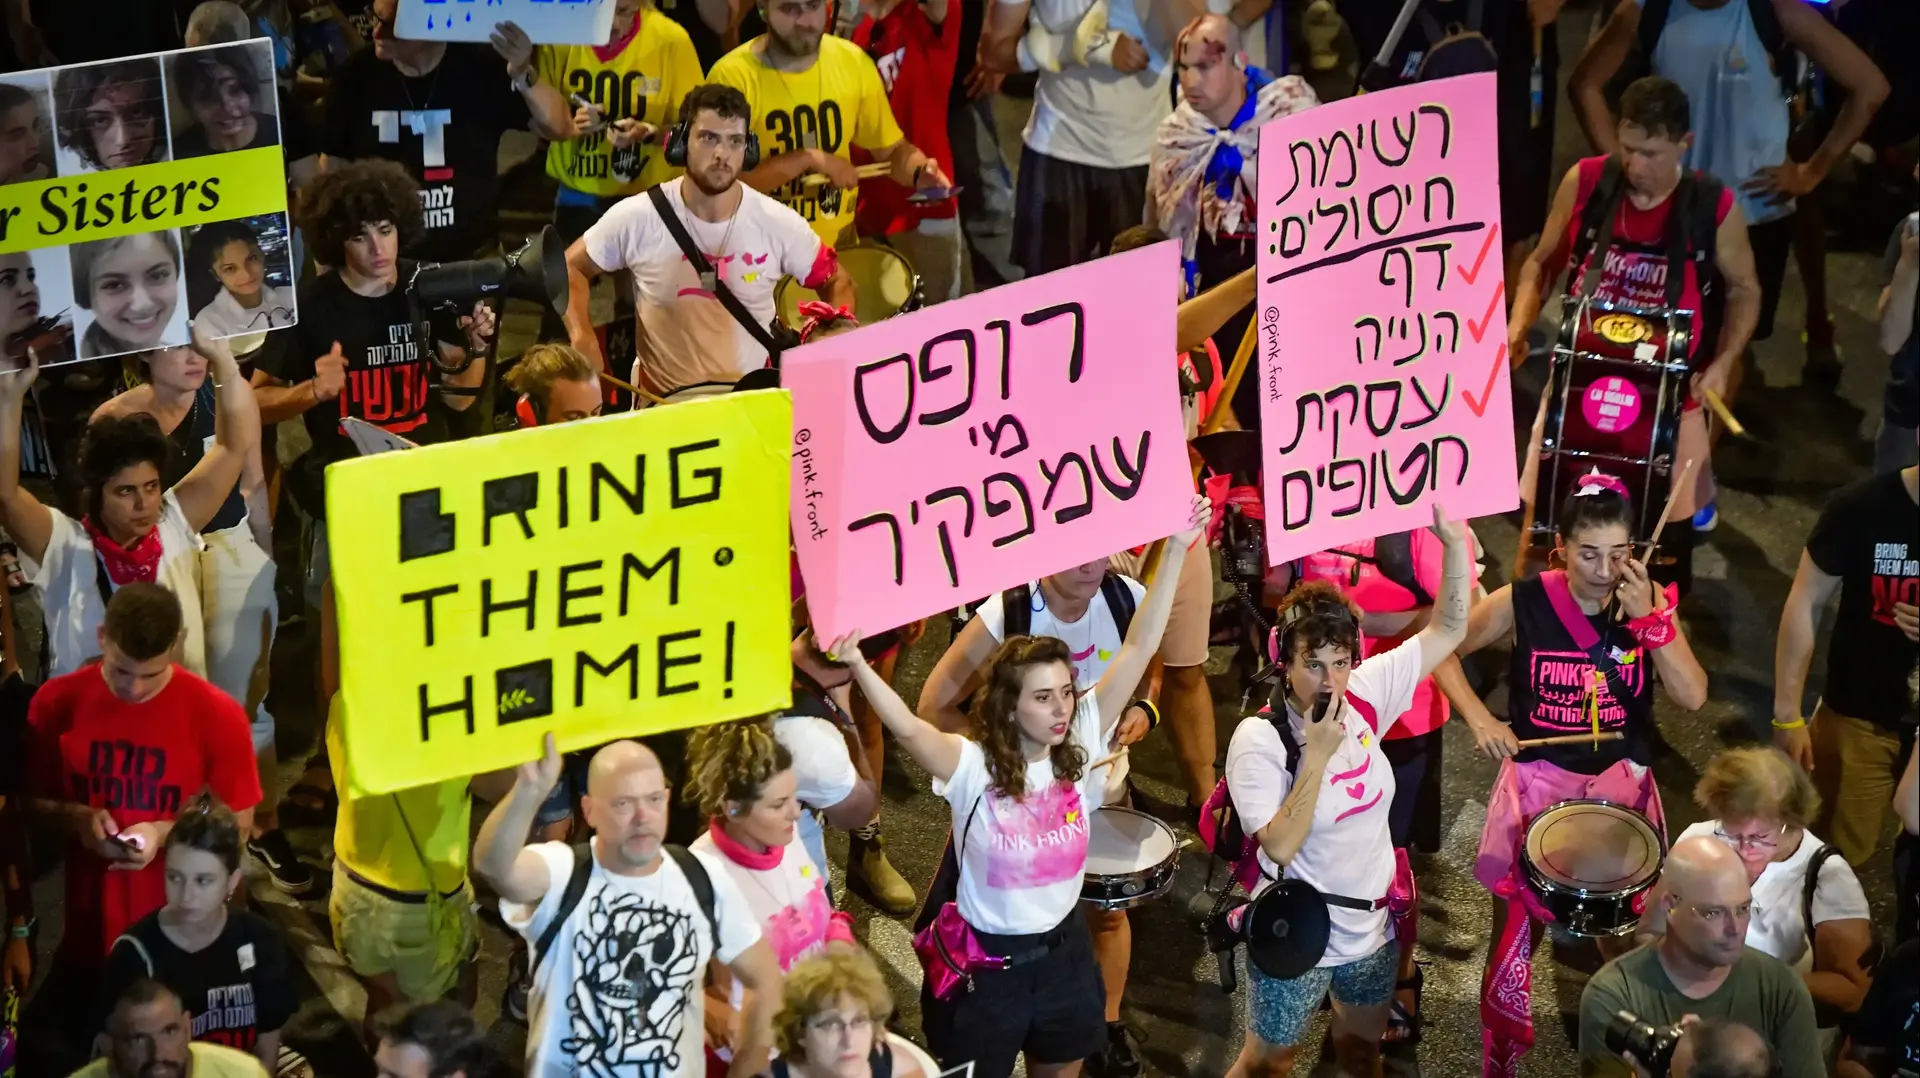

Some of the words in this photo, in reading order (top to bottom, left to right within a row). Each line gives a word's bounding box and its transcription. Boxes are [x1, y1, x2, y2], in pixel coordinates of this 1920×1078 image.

[1276, 104, 1450, 206] רשימת
[37, 177, 220, 236] Sisters
[1270, 177, 1454, 258] חיסולים:
[1379, 243, 1452, 308] דף
[367, 343, 404, 366] הביתה
[854, 302, 1084, 444] רופס
[1262, 306, 1283, 404] @pink.front
[1354, 311, 1459, 366] הנייה
[968, 414, 1029, 459] מי
[1279, 373, 1451, 459] עסקת
[399, 438, 722, 563] BRING
[792, 428, 828, 541] @pink.front
[848, 430, 1152, 588] שמפקיר
[1283, 436, 1469, 531] חטופים
[1873, 559, 1901, 576] THEM
[1902, 560, 1920, 576] HO
[1874, 543, 1908, 560] BRING
[401, 547, 680, 647] THEM
[419, 621, 735, 742] HOME!
